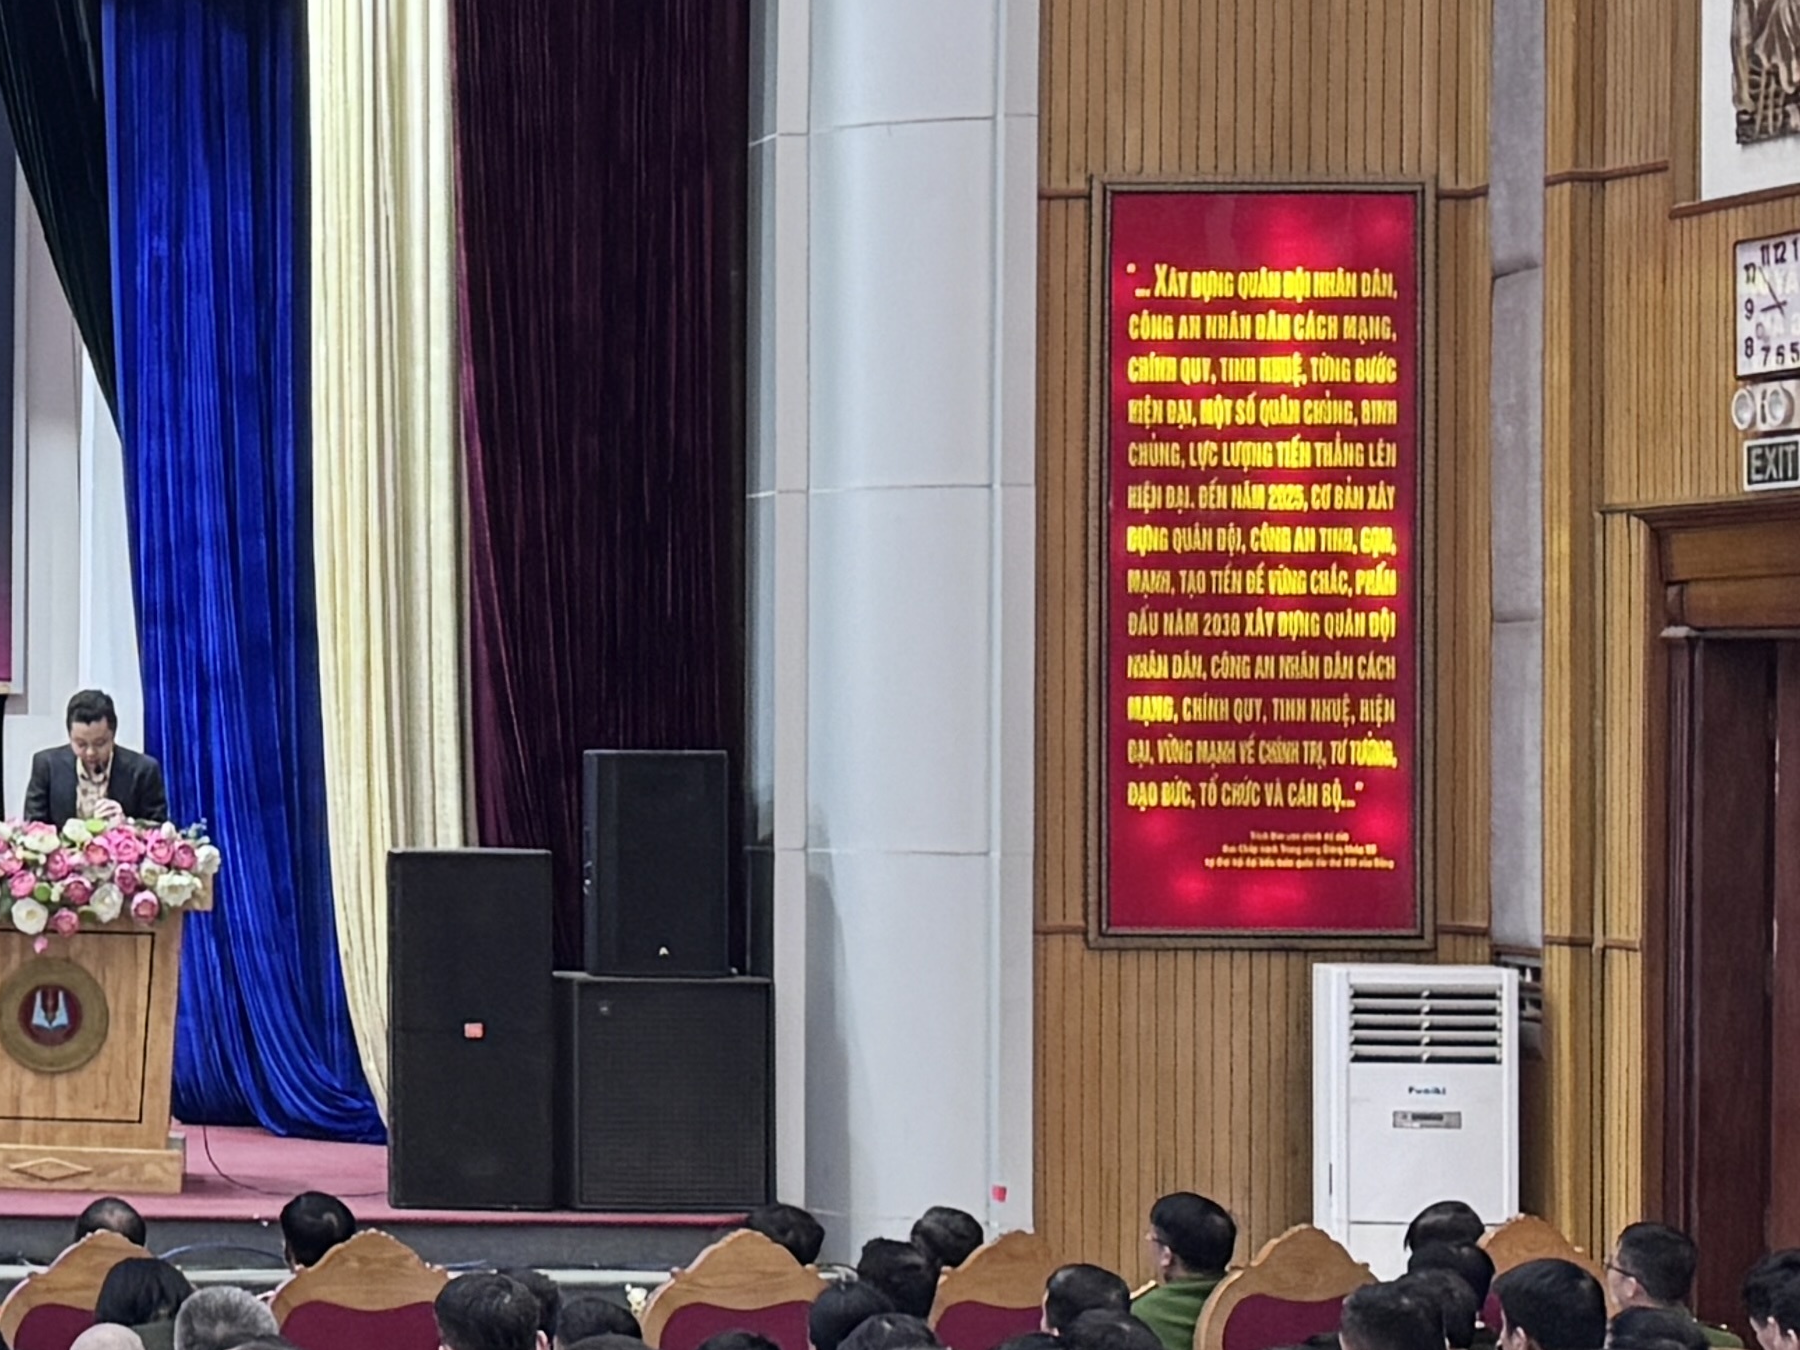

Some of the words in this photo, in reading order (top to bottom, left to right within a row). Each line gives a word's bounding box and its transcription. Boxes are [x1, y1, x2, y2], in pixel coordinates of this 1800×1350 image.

[1154, 264, 1188, 298] XÂY
[1191, 271, 1234, 303] DỰNG
[1238, 266, 1281, 300] QUÂN
[1283, 266, 1311, 303] ĐỘI
[1313, 267, 1357, 298] NHÂN
[1361, 268, 1397, 299] DÂN,
[1129, 310, 1174, 340] CÔNG
[1177, 315, 1200, 340] AN
[1206, 310, 1251, 340] NHÂN
[1255, 309, 1291, 340] DÂN
[1293, 310, 1338, 340] CÁCH
[1343, 315, 1397, 345] MẠNG,
[1744, 298, 1754, 320] 9
[1744, 337, 1753, 358] 8
[1761, 346, 1770, 367] 7
[1128, 432, 1185, 469] CHỦNG,
[1189, 440, 1218, 471] LỰC
[1222, 440, 1273, 473] LƯỢNG
[1275, 433, 1311, 468] TIẾN
[1368, 438, 1396, 467] LÊN
[1751, 448, 1796, 481] EXIT
[1128, 604, 1159, 637] ĐẤU
[1163, 607, 1199, 637] NĂM
[1203, 612, 1240, 637] 2030
[1245, 607, 1275, 637] XÂY
[1277, 611, 1320, 641] DỰNG
[1324, 607, 1365, 639] QUÂN
[1369, 607, 1395, 643] ĐỘI
[1128, 781, 1158, 812] ĐẠO
[1161, 775, 1195, 809] ĐỨC,
[1199, 772, 1218, 807] TỔ
[1221, 775, 1260, 807] CHỨC
[1265, 778, 1283, 807] VÀ
[1287, 778, 1318, 807] CÁN
